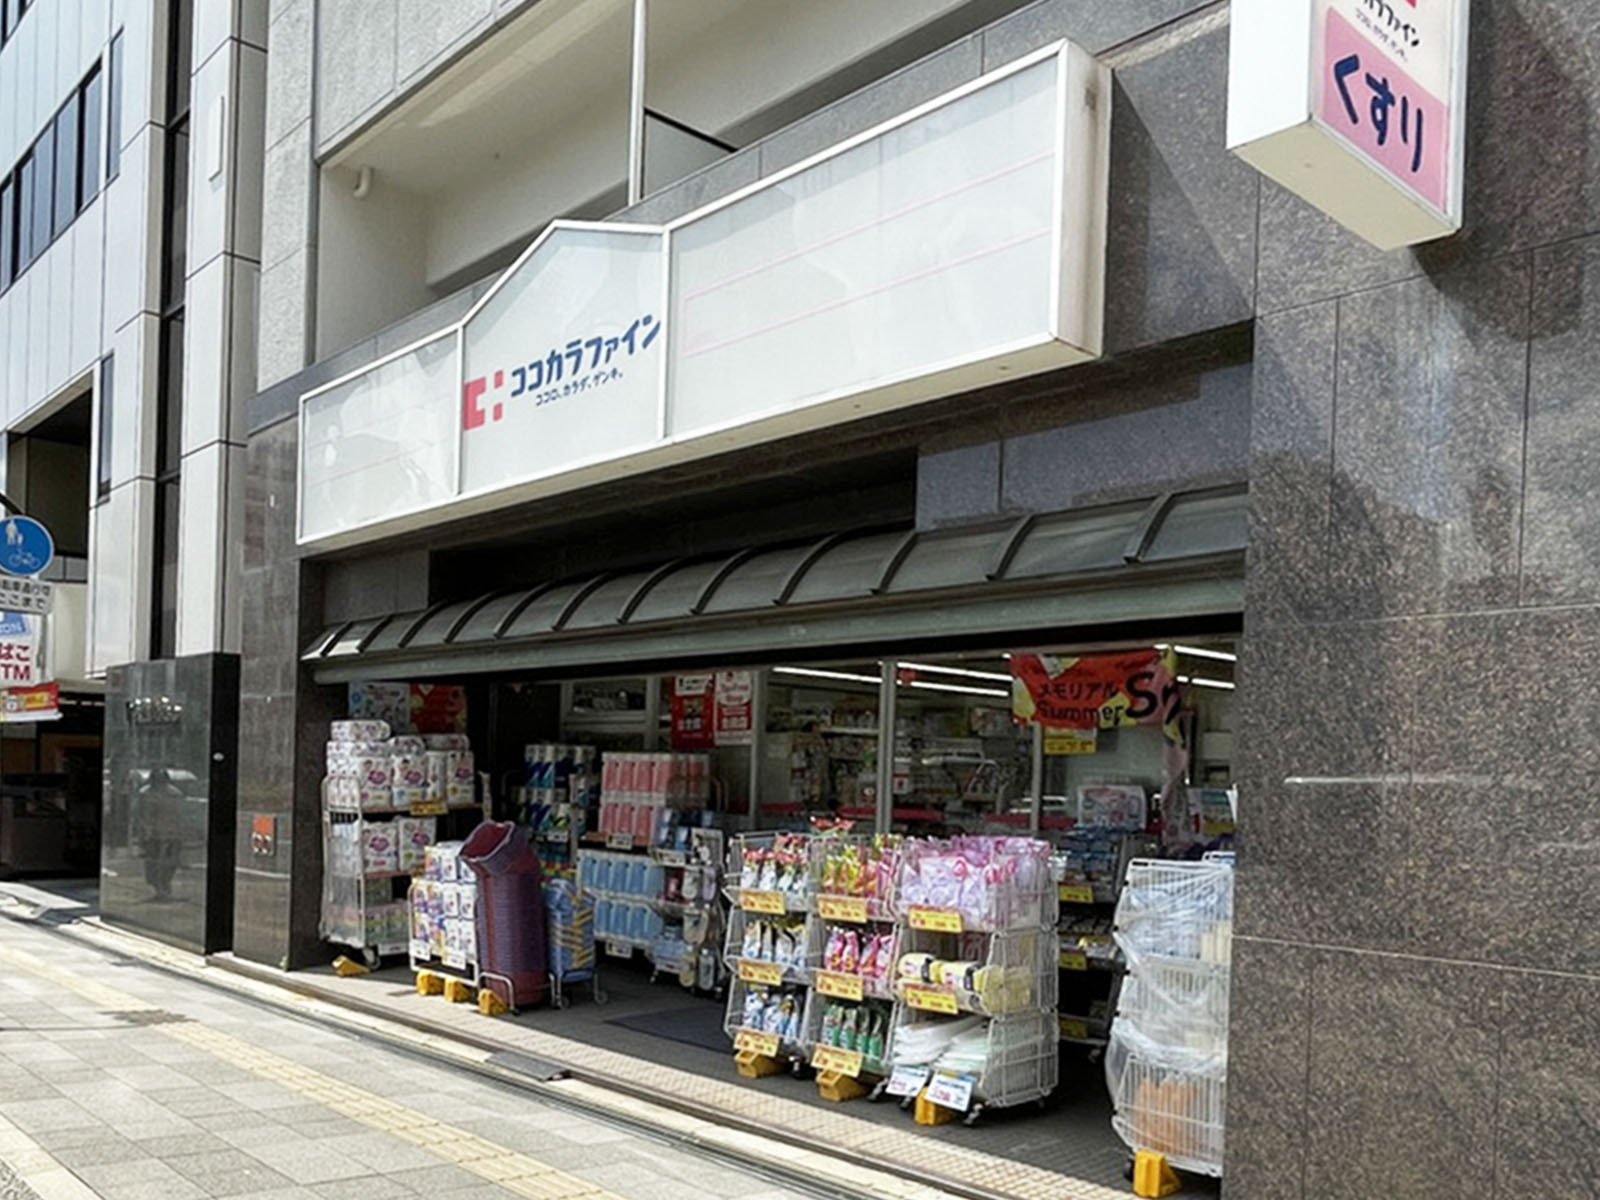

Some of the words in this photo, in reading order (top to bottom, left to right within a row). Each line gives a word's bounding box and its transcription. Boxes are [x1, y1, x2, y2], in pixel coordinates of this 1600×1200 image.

[1334, 54, 1423, 173] くすり
[510, 314, 662, 398] ココカラファイン
[1036, 701, 1124, 727] Summer
